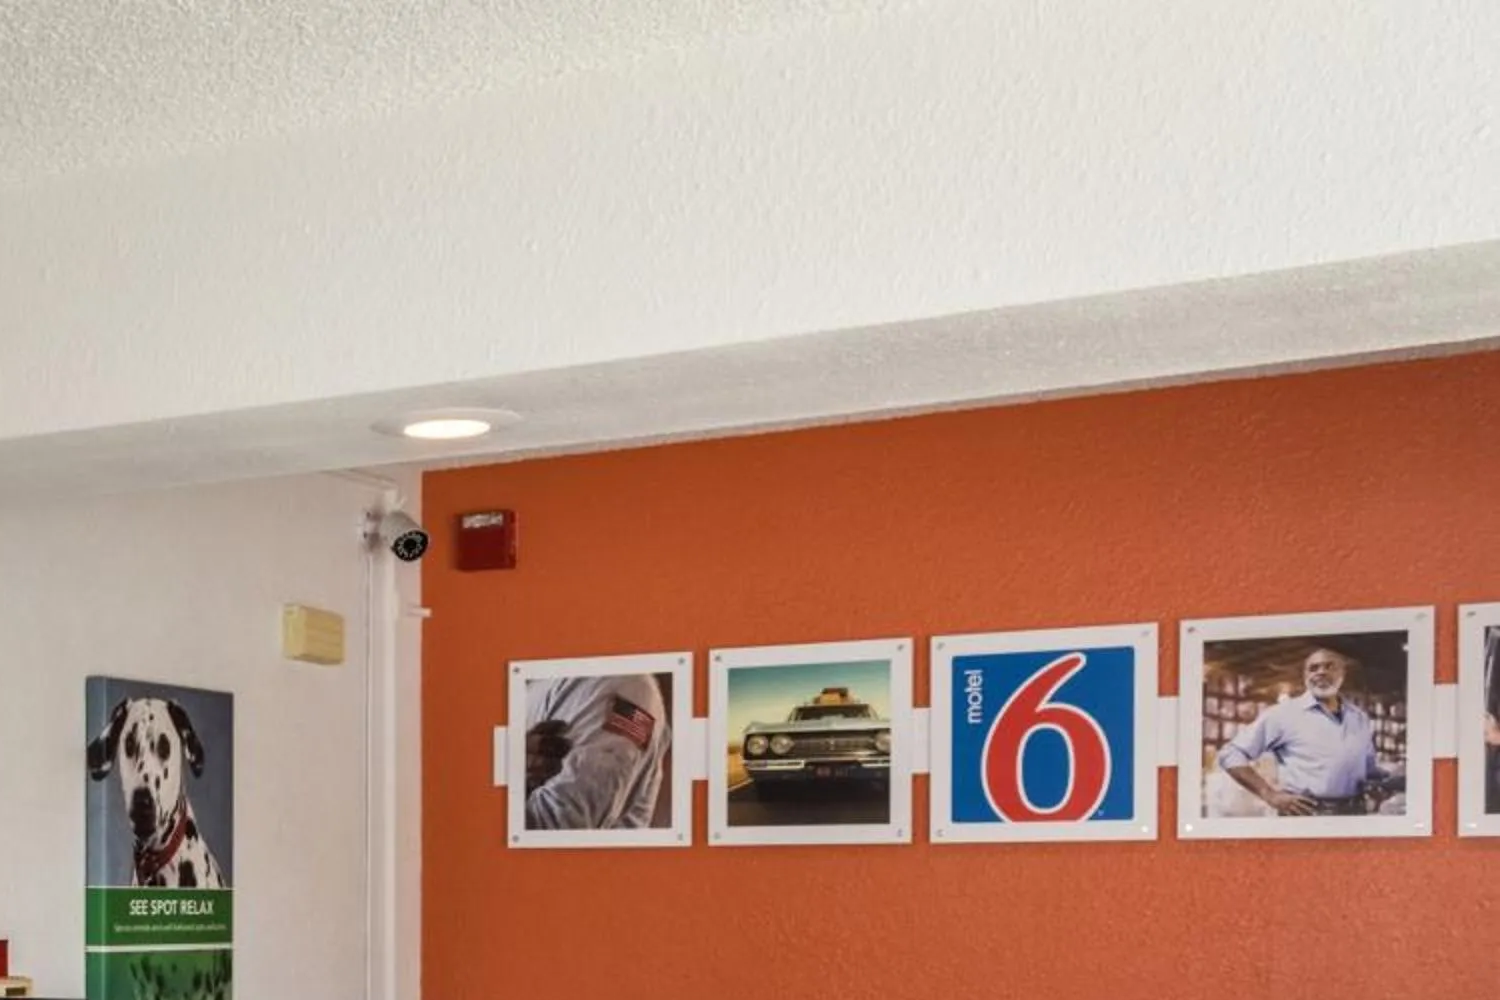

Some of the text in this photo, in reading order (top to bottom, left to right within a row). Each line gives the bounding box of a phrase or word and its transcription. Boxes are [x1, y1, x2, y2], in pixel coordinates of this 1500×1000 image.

[964, 668, 983, 725] motel
[981, 652, 1112, 825] 6
[128, 899, 215, 916] SEE SPOT RELAX
